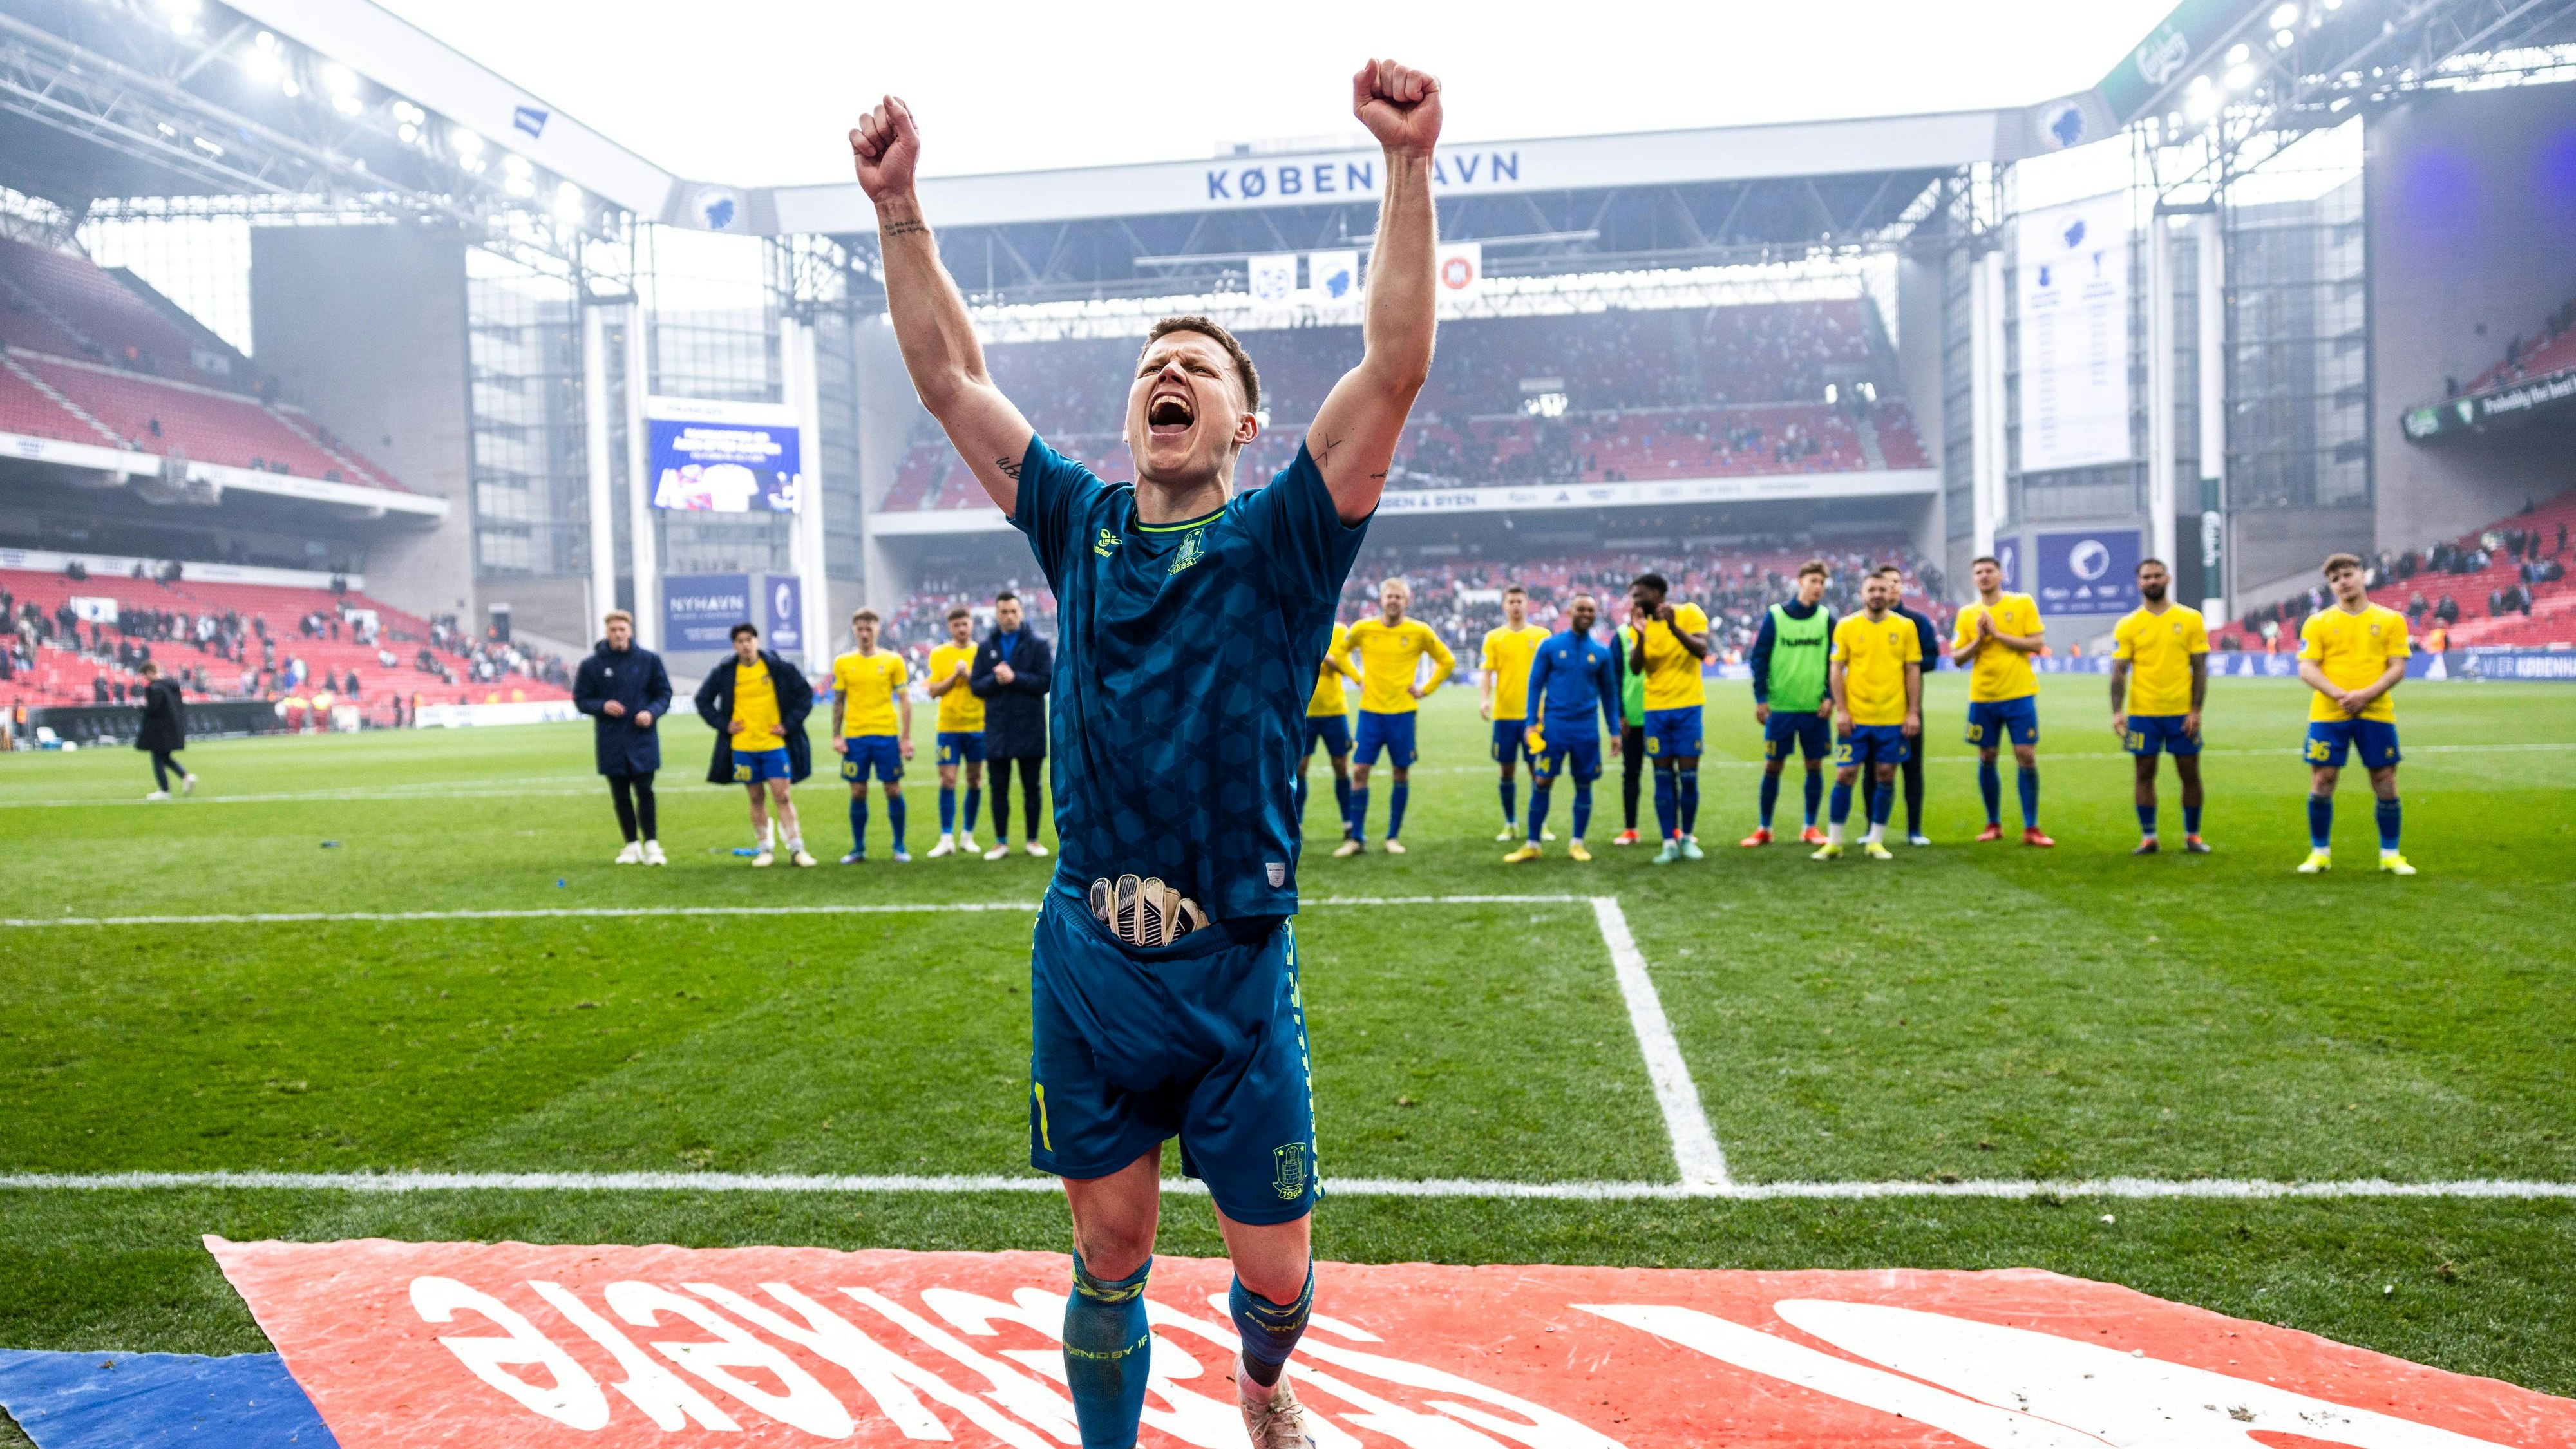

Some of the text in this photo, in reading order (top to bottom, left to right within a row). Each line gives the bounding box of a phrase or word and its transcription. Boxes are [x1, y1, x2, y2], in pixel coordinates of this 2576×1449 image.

[1208, 151, 1519, 200] KØBENAVN
[1172, 560, 1193, 575] 1964
[669, 594, 745, 612] NYHAVN
[2307, 739, 2331, 761] 36
[1034, 1081, 1053, 1153] 1
[1282, 1188, 1302, 1198] 1964
[1137, 1334, 1148, 1349] IF
